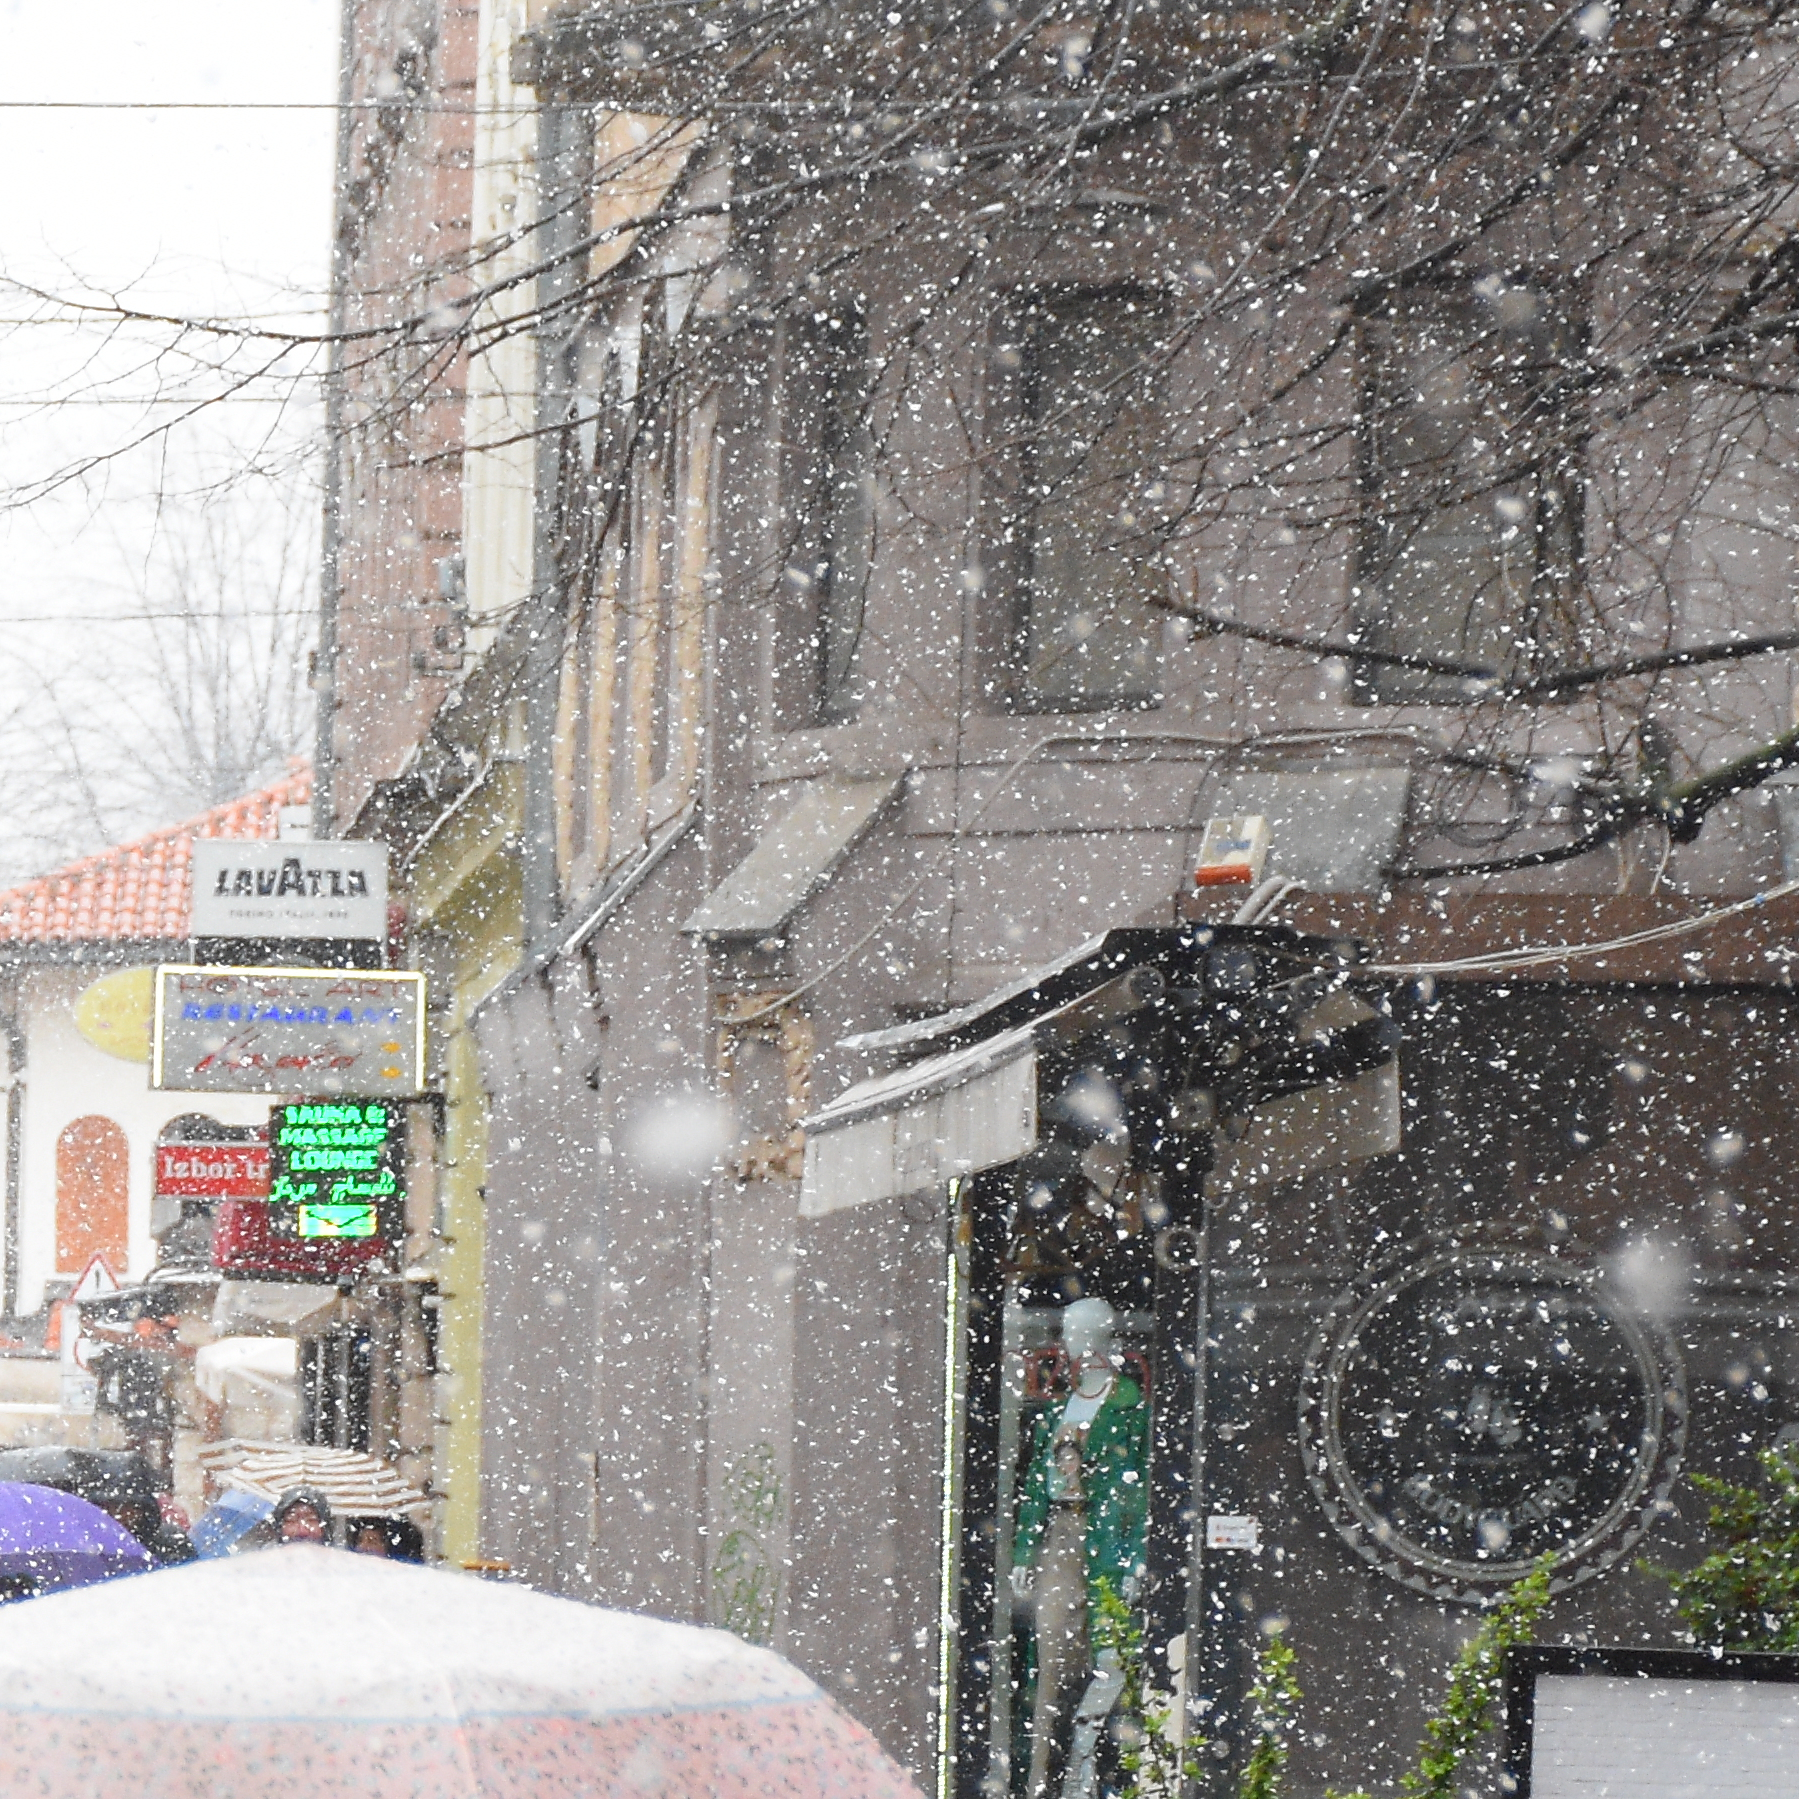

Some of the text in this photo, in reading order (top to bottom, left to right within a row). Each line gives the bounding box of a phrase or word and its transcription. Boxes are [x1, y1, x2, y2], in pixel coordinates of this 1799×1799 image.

[213, 857, 370, 898] LAVAZZA
[285, 1105, 362, 1124] SAUNA
[290, 1150, 378, 1171] LOUNGE
